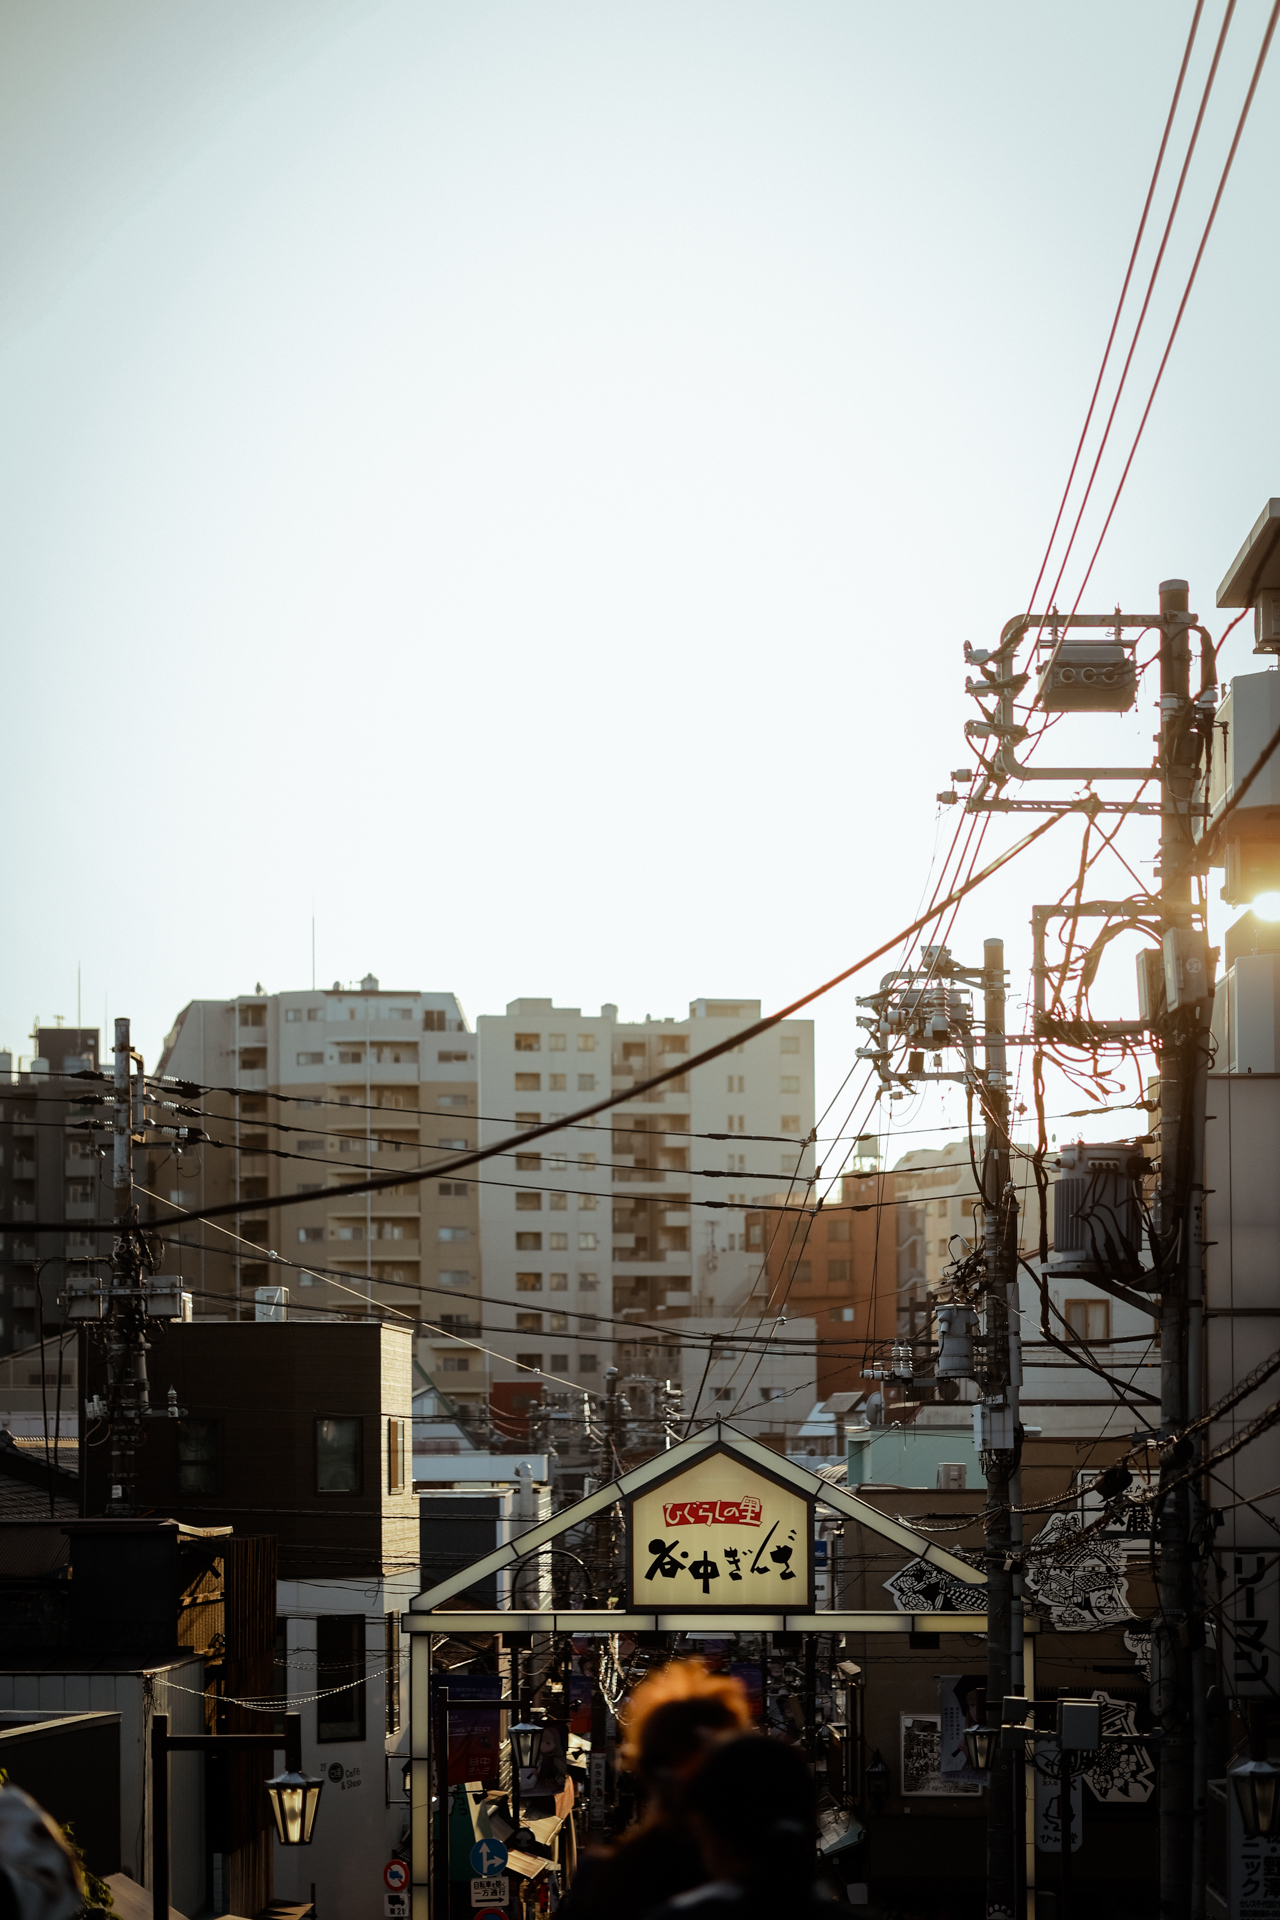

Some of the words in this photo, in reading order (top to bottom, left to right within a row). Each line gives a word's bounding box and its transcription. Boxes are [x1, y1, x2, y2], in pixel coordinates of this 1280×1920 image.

[664, 1496, 763, 1527] ひぐらしの里
[644, 1520, 797, 1595] 谷中ぎんざ
[1233, 1551, 1268, 1682] リーマン
[468, 1757, 491, 1766] 谷中
[345, 1767, 361, 1778] Café
[346, 1780, 362, 1789] Shop
[1039, 1832, 1078, 1844] ひみ堂
[1241, 1834, 1261, 1898] ニック
[474, 1880, 506, 1890] 自転車を除く
[474, 1889, 506, 1898] 一方通行
